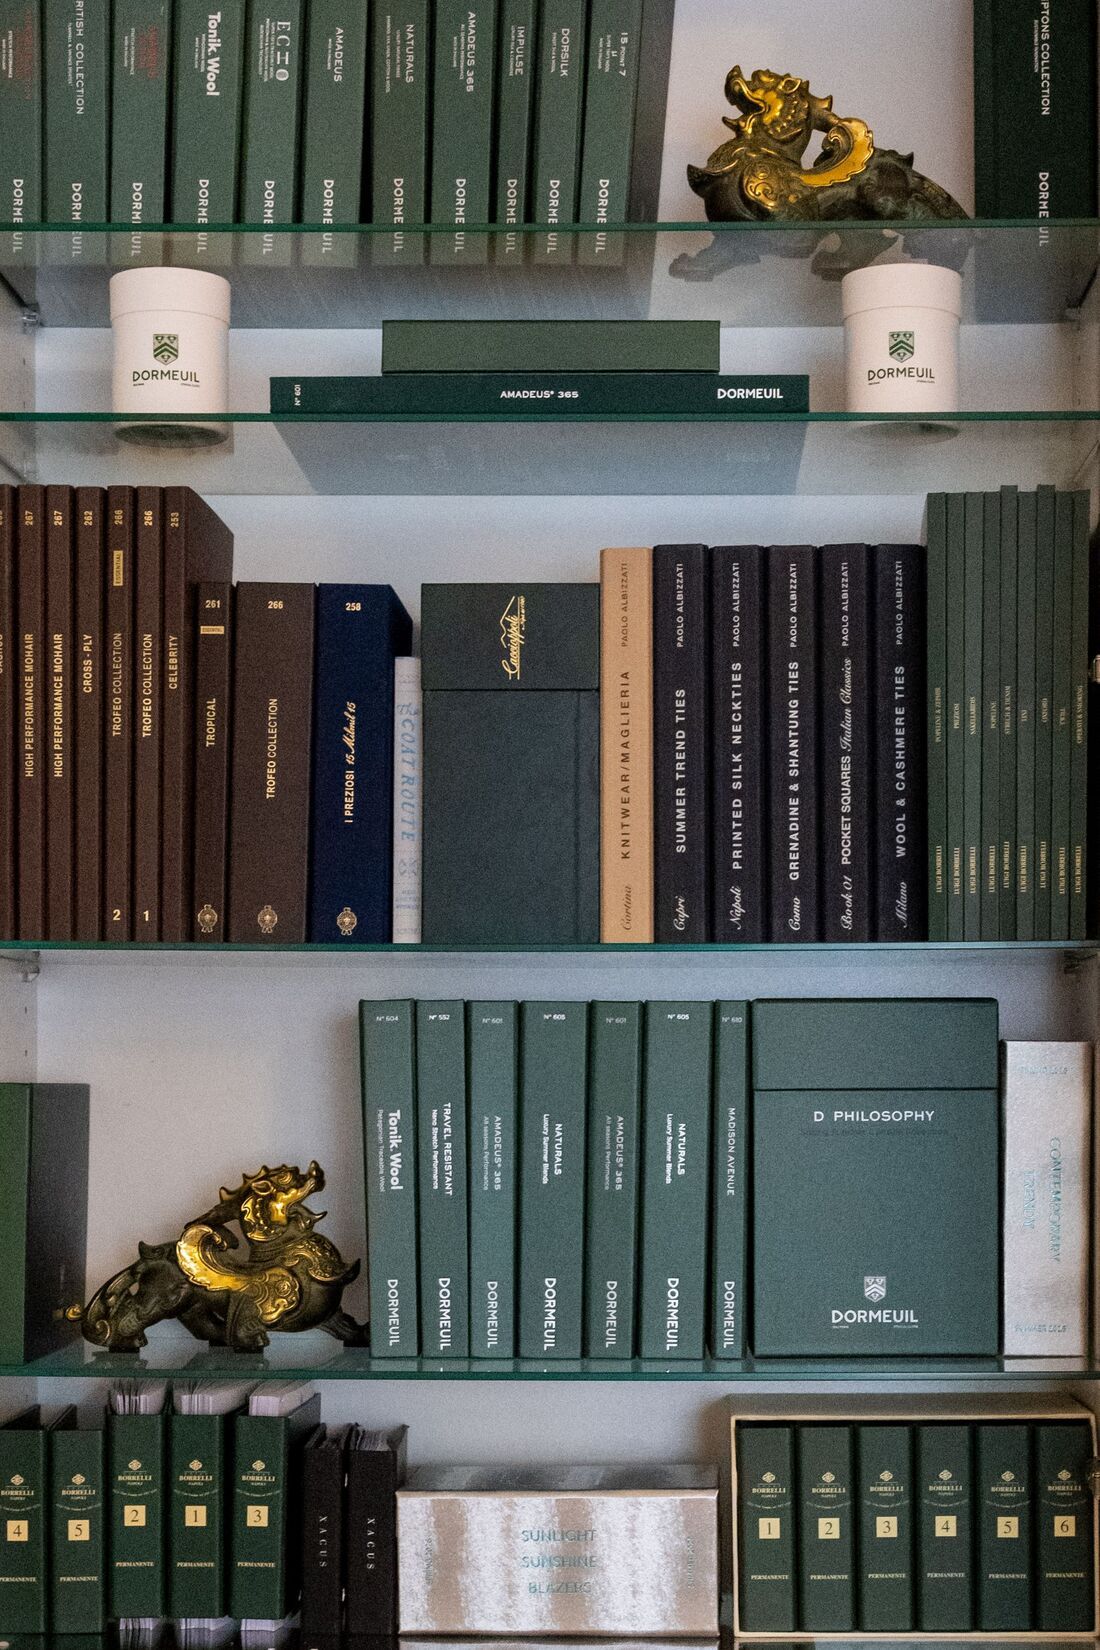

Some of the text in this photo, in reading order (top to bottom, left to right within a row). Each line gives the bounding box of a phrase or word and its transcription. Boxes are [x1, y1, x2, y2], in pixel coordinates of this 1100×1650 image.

[333, 27, 344, 82] AMADEUS
[405, 24, 415, 84] NATURALS
[465, 11, 476, 93] AMADEUS 365
[514, 26, 525, 75] IMPULSE
[559, 28, 571, 77] DORSILK
[618, 69, 627, 77] 7
[75, 42, 85, 115] COLLECTION
[206, 56, 221, 96] Wool
[1040, 42, 1051, 116] COLLECTION
[132, 369, 200, 383] DORMEUIL
[294, 384, 302, 397] 601
[557, 390, 579, 399] 365
[717, 388, 784, 400] DORMEUIL
[867, 366, 935, 382] DORMEUIL
[24, 510, 34, 526] 267
[53, 510, 63, 526] 267
[83, 510, 93, 526] 262
[114, 509, 124, 525] 266
[143, 510, 153, 526] 266
[170, 512, 180, 528] 253
[205, 599, 221, 609] 261
[267, 600, 284, 610] 266
[345, 602, 362, 612] 258
[620, 562, 629, 648] PAOLO ALBIZZATI
[676, 563, 684, 648] PAOLO ALBIZZATI
[732, 562, 740, 647] PAOLO ALBIZZATI
[789, 563, 798, 648] PAOLO ALBIZZATI
[841, 562, 849, 647] PAOLO ALBIZZATI
[895, 560, 904, 645] PAOLO ALBIZZATI
[82, 634, 93, 693] CROSS PLY
[112, 632, 123, 737] TROFEO COLLECTION
[142, 633, 153, 738] TROFEO COLLECTION
[168, 635, 178, 690] CELEBRITY
[24, 633, 34, 777] HIGH PERFORMANCE MOHAIR
[53, 633, 64, 778] HIGH PERFORMANCE MOHAIR
[205, 697, 216, 748] TROPICAL
[346, 701, 356, 713] 15
[266, 698, 278, 799] TROFEO COLLECTION
[345, 753, 355, 765] 15
[620, 671, 631, 860] KNITWEAR/MAGLIERIA
[675, 689, 687, 853] SUMMER TREND TIES
[731, 662, 743, 870] PRINTED SILK NECKTIES
[788, 661, 800, 881] GRENADINE & SHANTUNG TIES
[839, 658, 852, 865] POCKET SQUARES Italian Classics
[894, 666, 906, 858] WOOL & CASHMERE TIES
[344, 770, 355, 817] PREZIOSI
[401, 719, 415, 842] COAT ROUTE
[112, 908, 121, 921] 2
[143, 910, 149, 922] 1
[621, 885, 632, 931] Cortina
[673, 897, 690, 931] Capri
[729, 885, 746, 931] Napoli
[788, 896, 801, 931] Como
[840, 875, 853, 931] Book 01
[895, 881, 908, 929] Milano
[813, 1110, 935, 1122] D PHILOSOPHY
[388, 1109, 404, 1190] Tonik. Wool
[443, 1102, 453, 1196] TRAVEL RESISTANT
[553, 1123, 563, 1176] NATURALS
[677, 1123, 686, 1176] NATURALS
[726, 1107, 736, 1196] MADISON AVENUE
[493, 1170, 502, 1191] 365
[615, 1170, 623, 1191] 365
[387, 1279, 400, 1347] DORMEUIL
[438, 1277, 452, 1351] DORMEUIL
[486, 1281, 499, 1349] DORMEUIL
[543, 1277, 557, 1351] DORMEUIL
[605, 1280, 618, 1348] DORMEUIL
[666, 1277, 680, 1351] DORMEUIL
[723, 1281, 736, 1349] DORMEUIL
[831, 1309, 919, 1324] DORMEUIL
[12, 1524, 23, 1537] 4
[74, 1523, 83, 1537] 5
[130, 1509, 140, 1523] 2
[193, 1510, 198, 1523] 1
[253, 1509, 262, 1523] 3
[522, 1530, 596, 1542] SUNLIGHT
[766, 1522, 772, 1536] 1
[824, 1521, 833, 1535] 2
[882, 1520, 892, 1534] 3
[941, 1520, 951, 1533] 4
[1003, 1520, 1012, 1534] 5
[1060, 1519, 1069, 1533] 6
[319, 1516, 328, 1567] XACUS
[366, 1518, 376, 1570] XACUS
[521, 1556, 597, 1568] SUNSHINE
